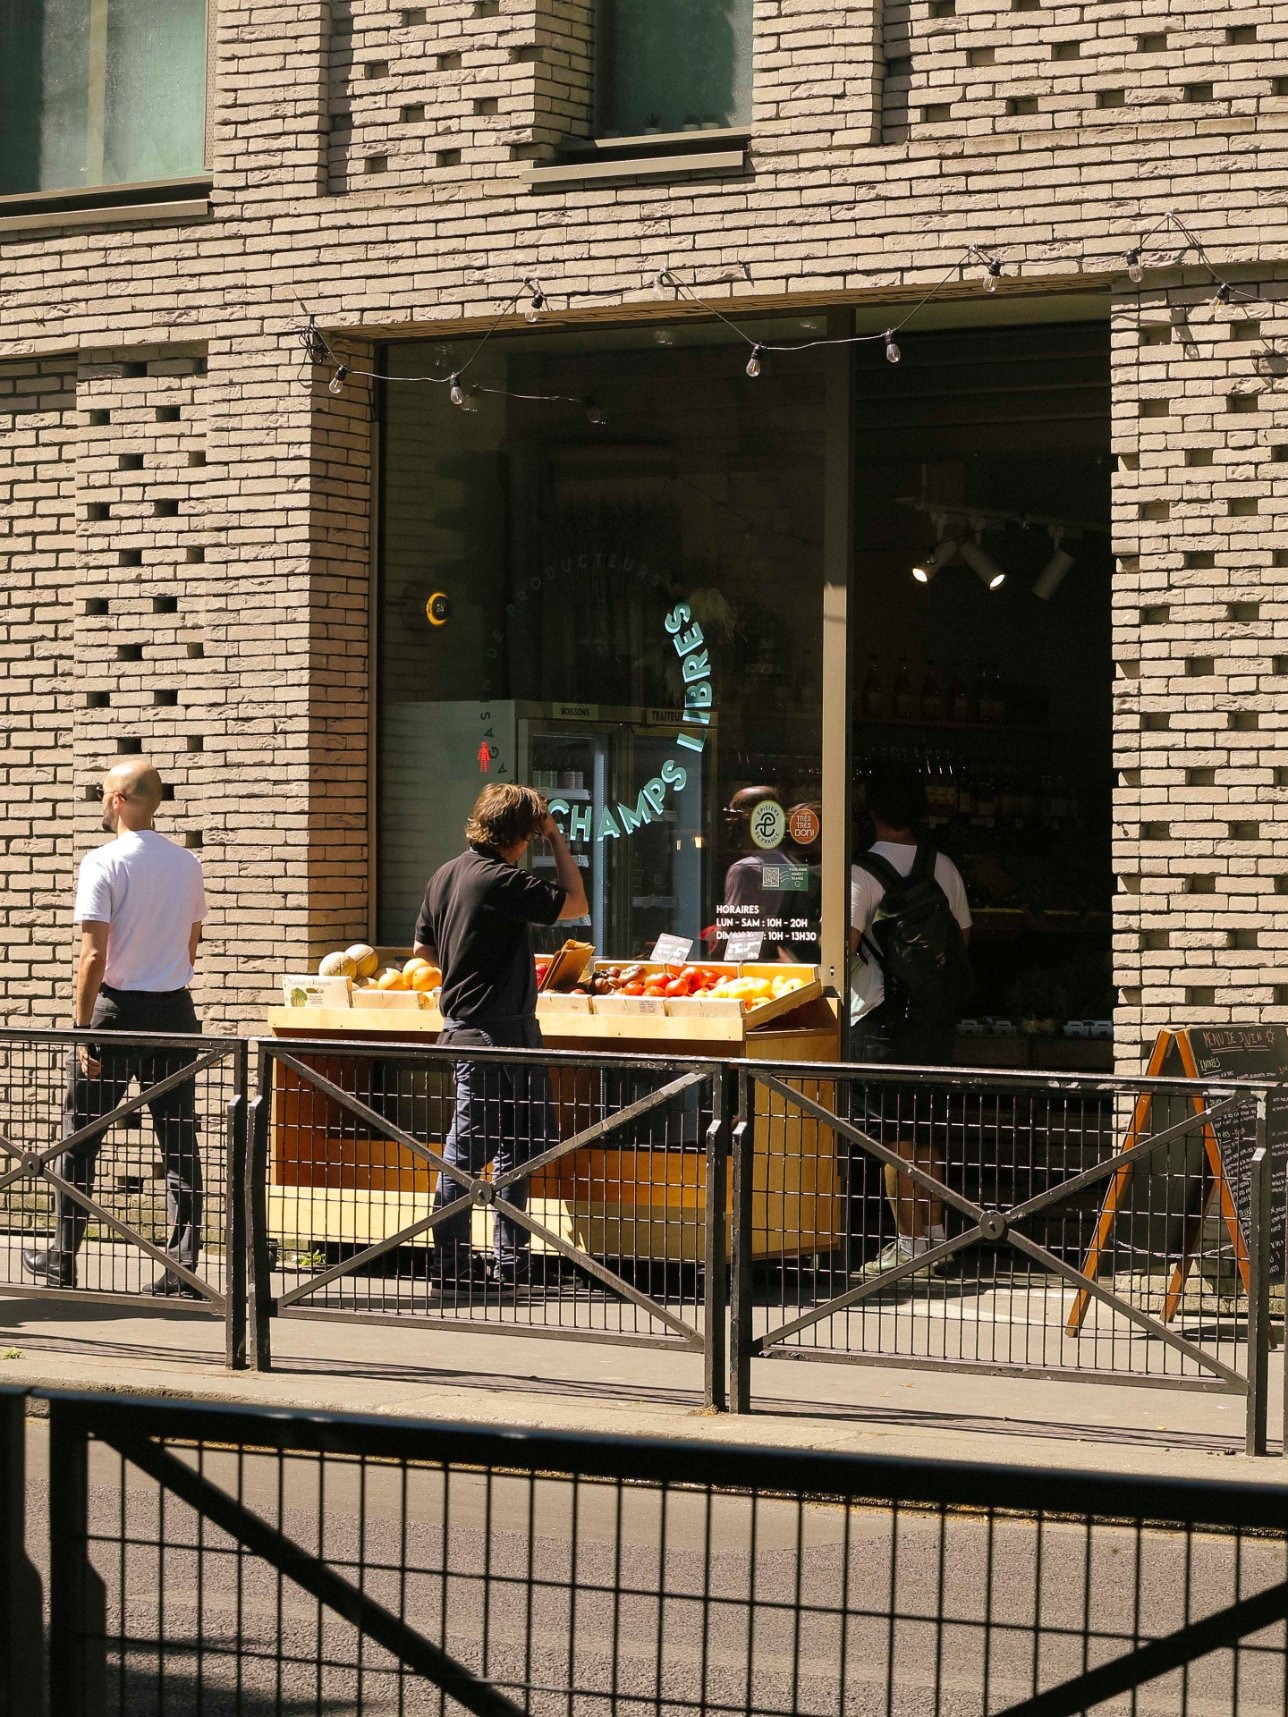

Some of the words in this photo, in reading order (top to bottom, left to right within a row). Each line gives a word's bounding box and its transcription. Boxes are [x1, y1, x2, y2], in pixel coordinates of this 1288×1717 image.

[664, 601, 713, 753] LIBRES
[561, 706, 590, 717] BOISSONS
[716, 904, 760, 915] HORAIRES
[716, 918, 734, 928] LUN
[741, 918, 760, 928] SAM
[767, 918, 782, 928] 10H
[790, 918, 808, 928] 20H
[768, 931, 783, 941] 10H
[791, 931, 817, 941] 13H30
